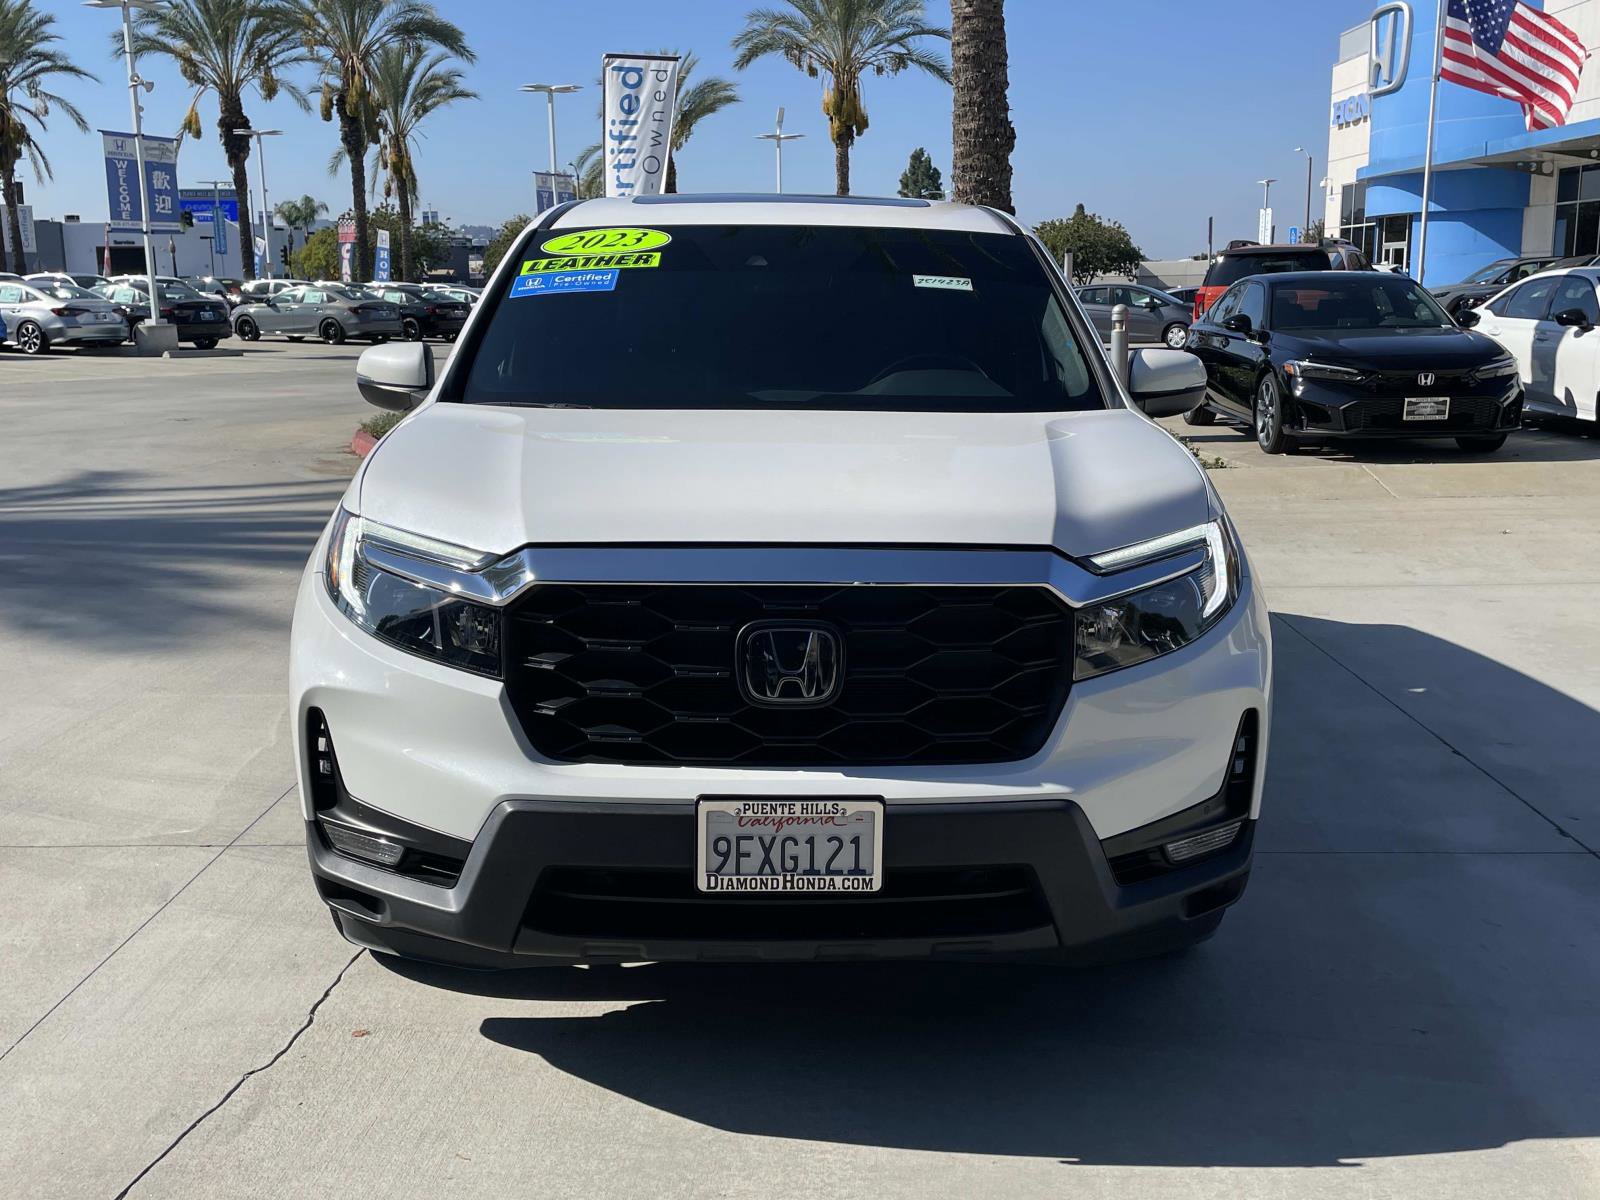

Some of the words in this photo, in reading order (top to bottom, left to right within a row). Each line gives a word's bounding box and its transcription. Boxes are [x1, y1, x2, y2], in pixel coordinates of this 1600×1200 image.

[112, 159, 131, 220] WELCOME
[560, 232, 649, 250] 2023
[528, 254, 654, 272] LEATHER
[555, 272, 612, 283] Certified
[743, 803, 796, 815] PUENTE
[800, 803, 839, 815] HILLS
[712, 835, 867, 875] 9FXG121
